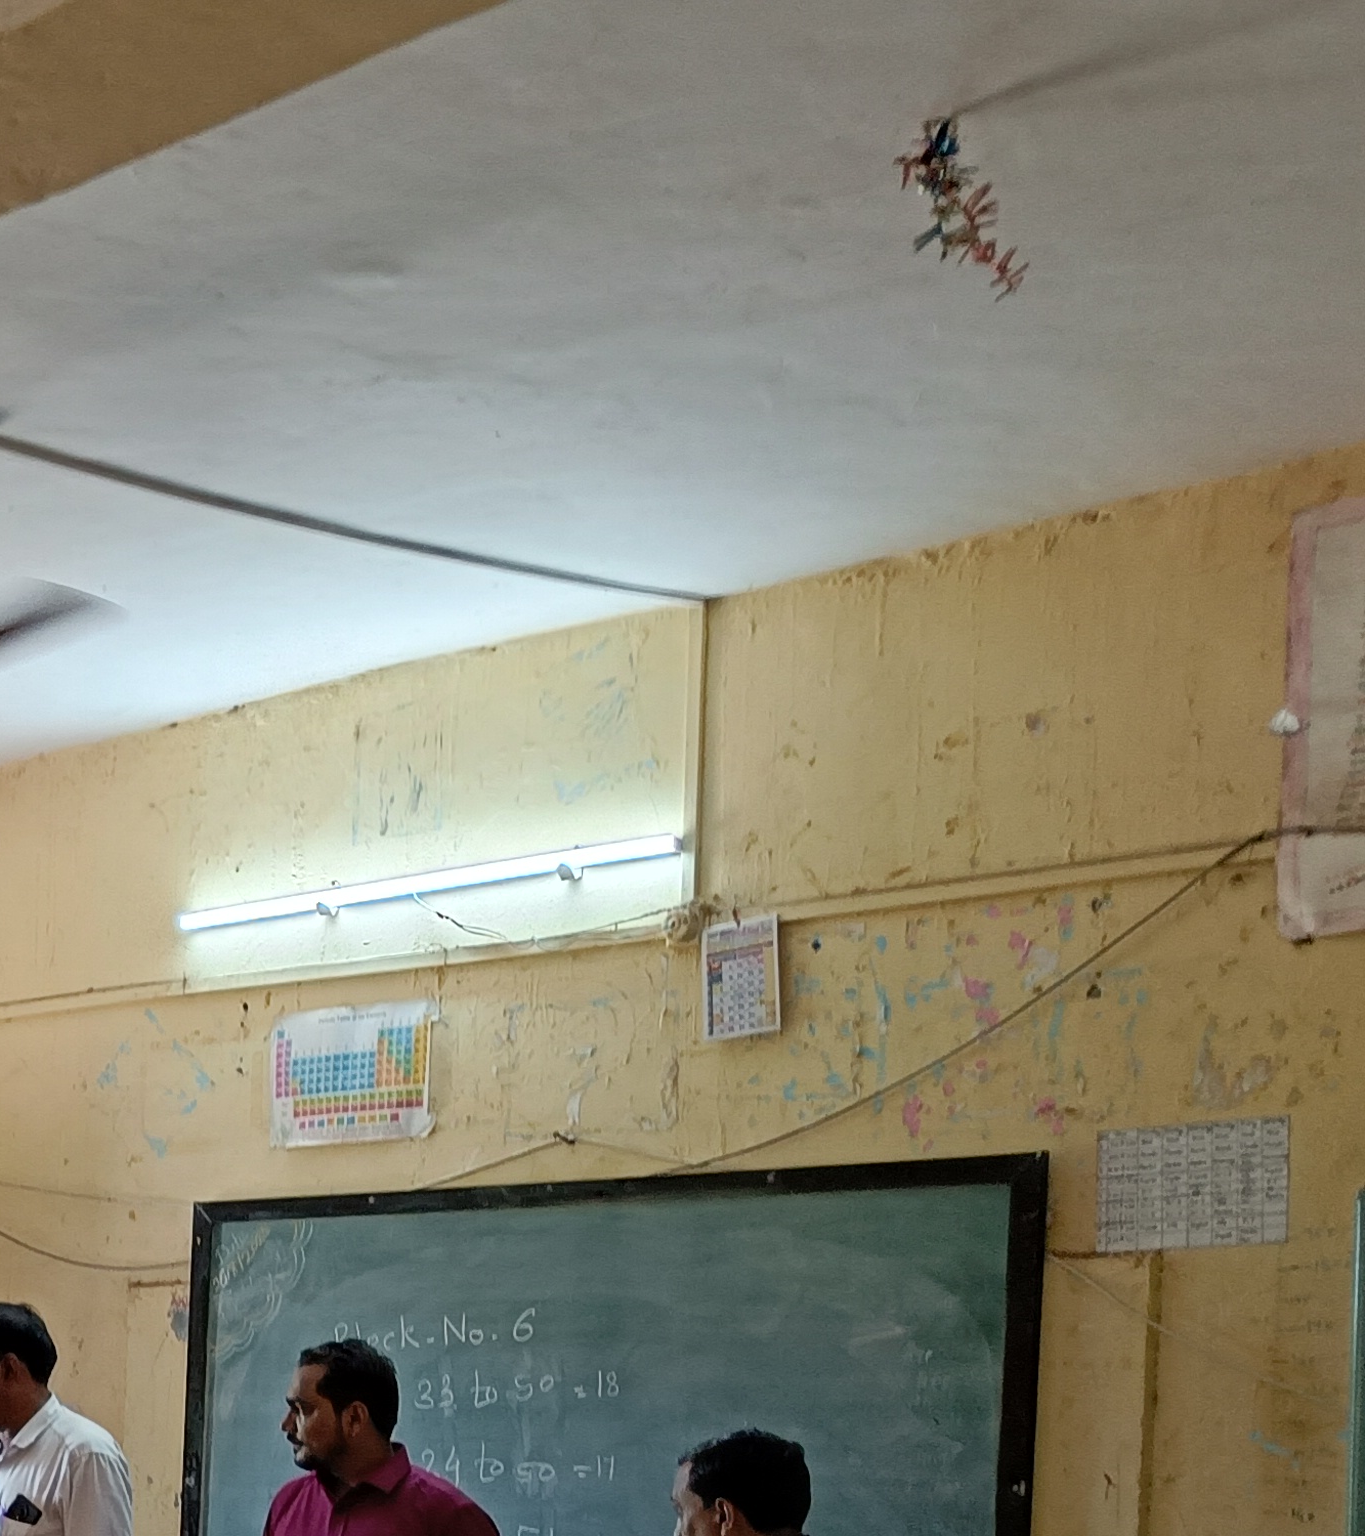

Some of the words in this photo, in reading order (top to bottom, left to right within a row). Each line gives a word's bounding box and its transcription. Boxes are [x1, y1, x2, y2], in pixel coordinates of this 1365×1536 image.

[512, 1307, 537, 1342] 6
[469, 1369, 499, 1409] to
[474, 1441, 505, 1484] to
